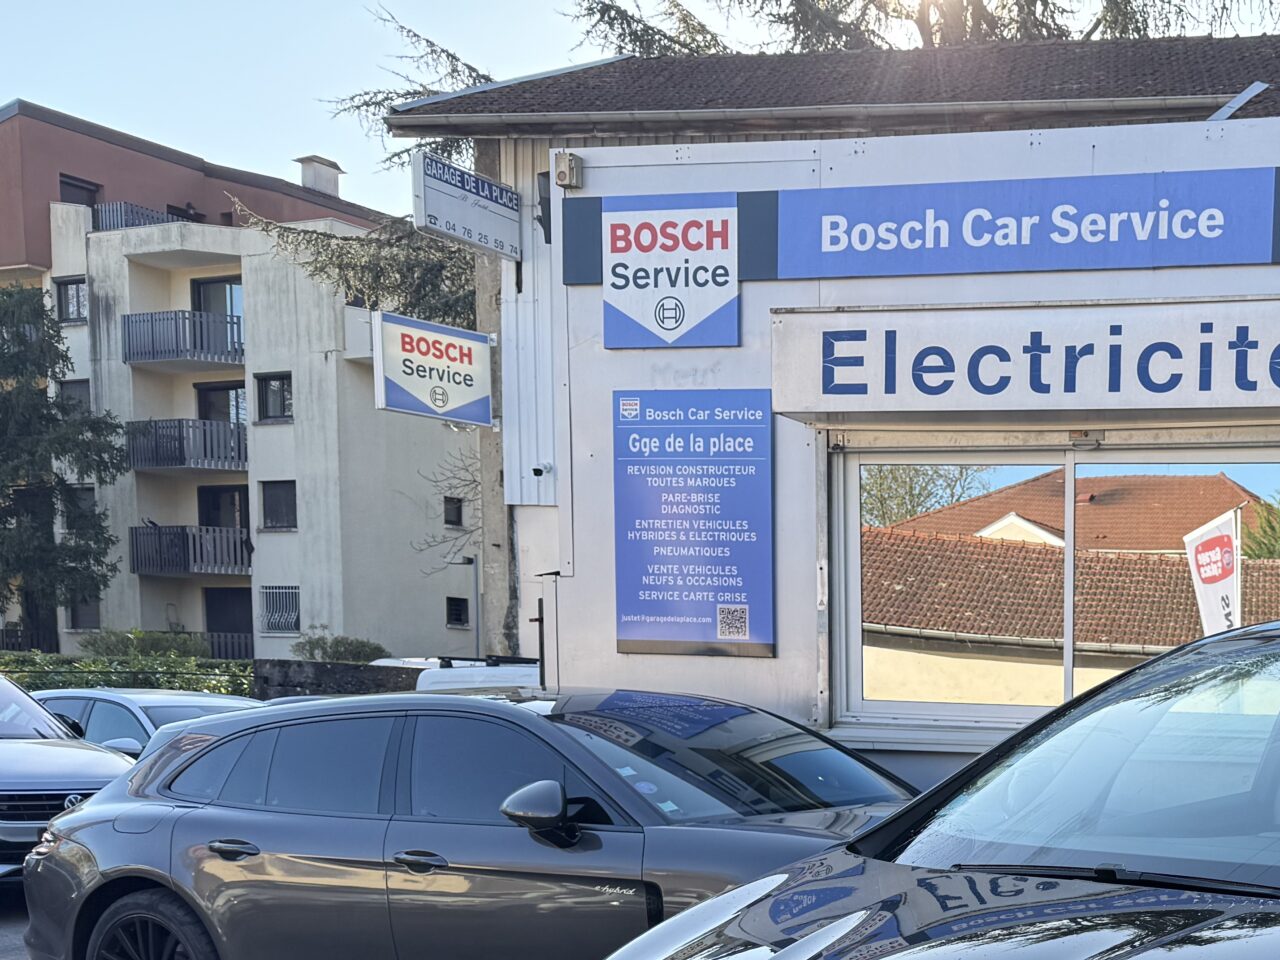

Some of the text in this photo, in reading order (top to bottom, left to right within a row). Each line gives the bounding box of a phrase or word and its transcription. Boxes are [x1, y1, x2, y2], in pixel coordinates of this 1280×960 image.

[424, 157, 519, 210] GARAGE DE LA PLACE
[821, 199, 1225, 253] Bosch Car Service
[445, 220, 519, 256] 04 76 25 59 74
[610, 219, 729, 253] BOSCH
[610, 258, 730, 290] Service
[400, 332, 473, 366] BOSCH
[402, 358, 474, 388] Service
[645, 407, 763, 420] Bosch Car Service
[628, 432, 754, 456] Gge de la place
[627, 465, 756, 475] REVISION CONSTRUCTEUR
[646, 477, 736, 487] TOUTES MARQUES
[661, 493, 721, 503] PARE-BRISE
[661, 505, 721, 514] DIAGNOSTIC
[635, 520, 749, 529] ENTRETIEN VEHICULES
[627, 531, 757, 542] HYBRIDES & ELECTRIQUES
[653, 547, 731, 557] PNEUMATIQUES
[647, 564, 738, 575] VENTE VEHICULES
[642, 576, 743, 586] NEUFS & OCCASIONS
[638, 591, 747, 602] SERVICE CARTE GRISE
